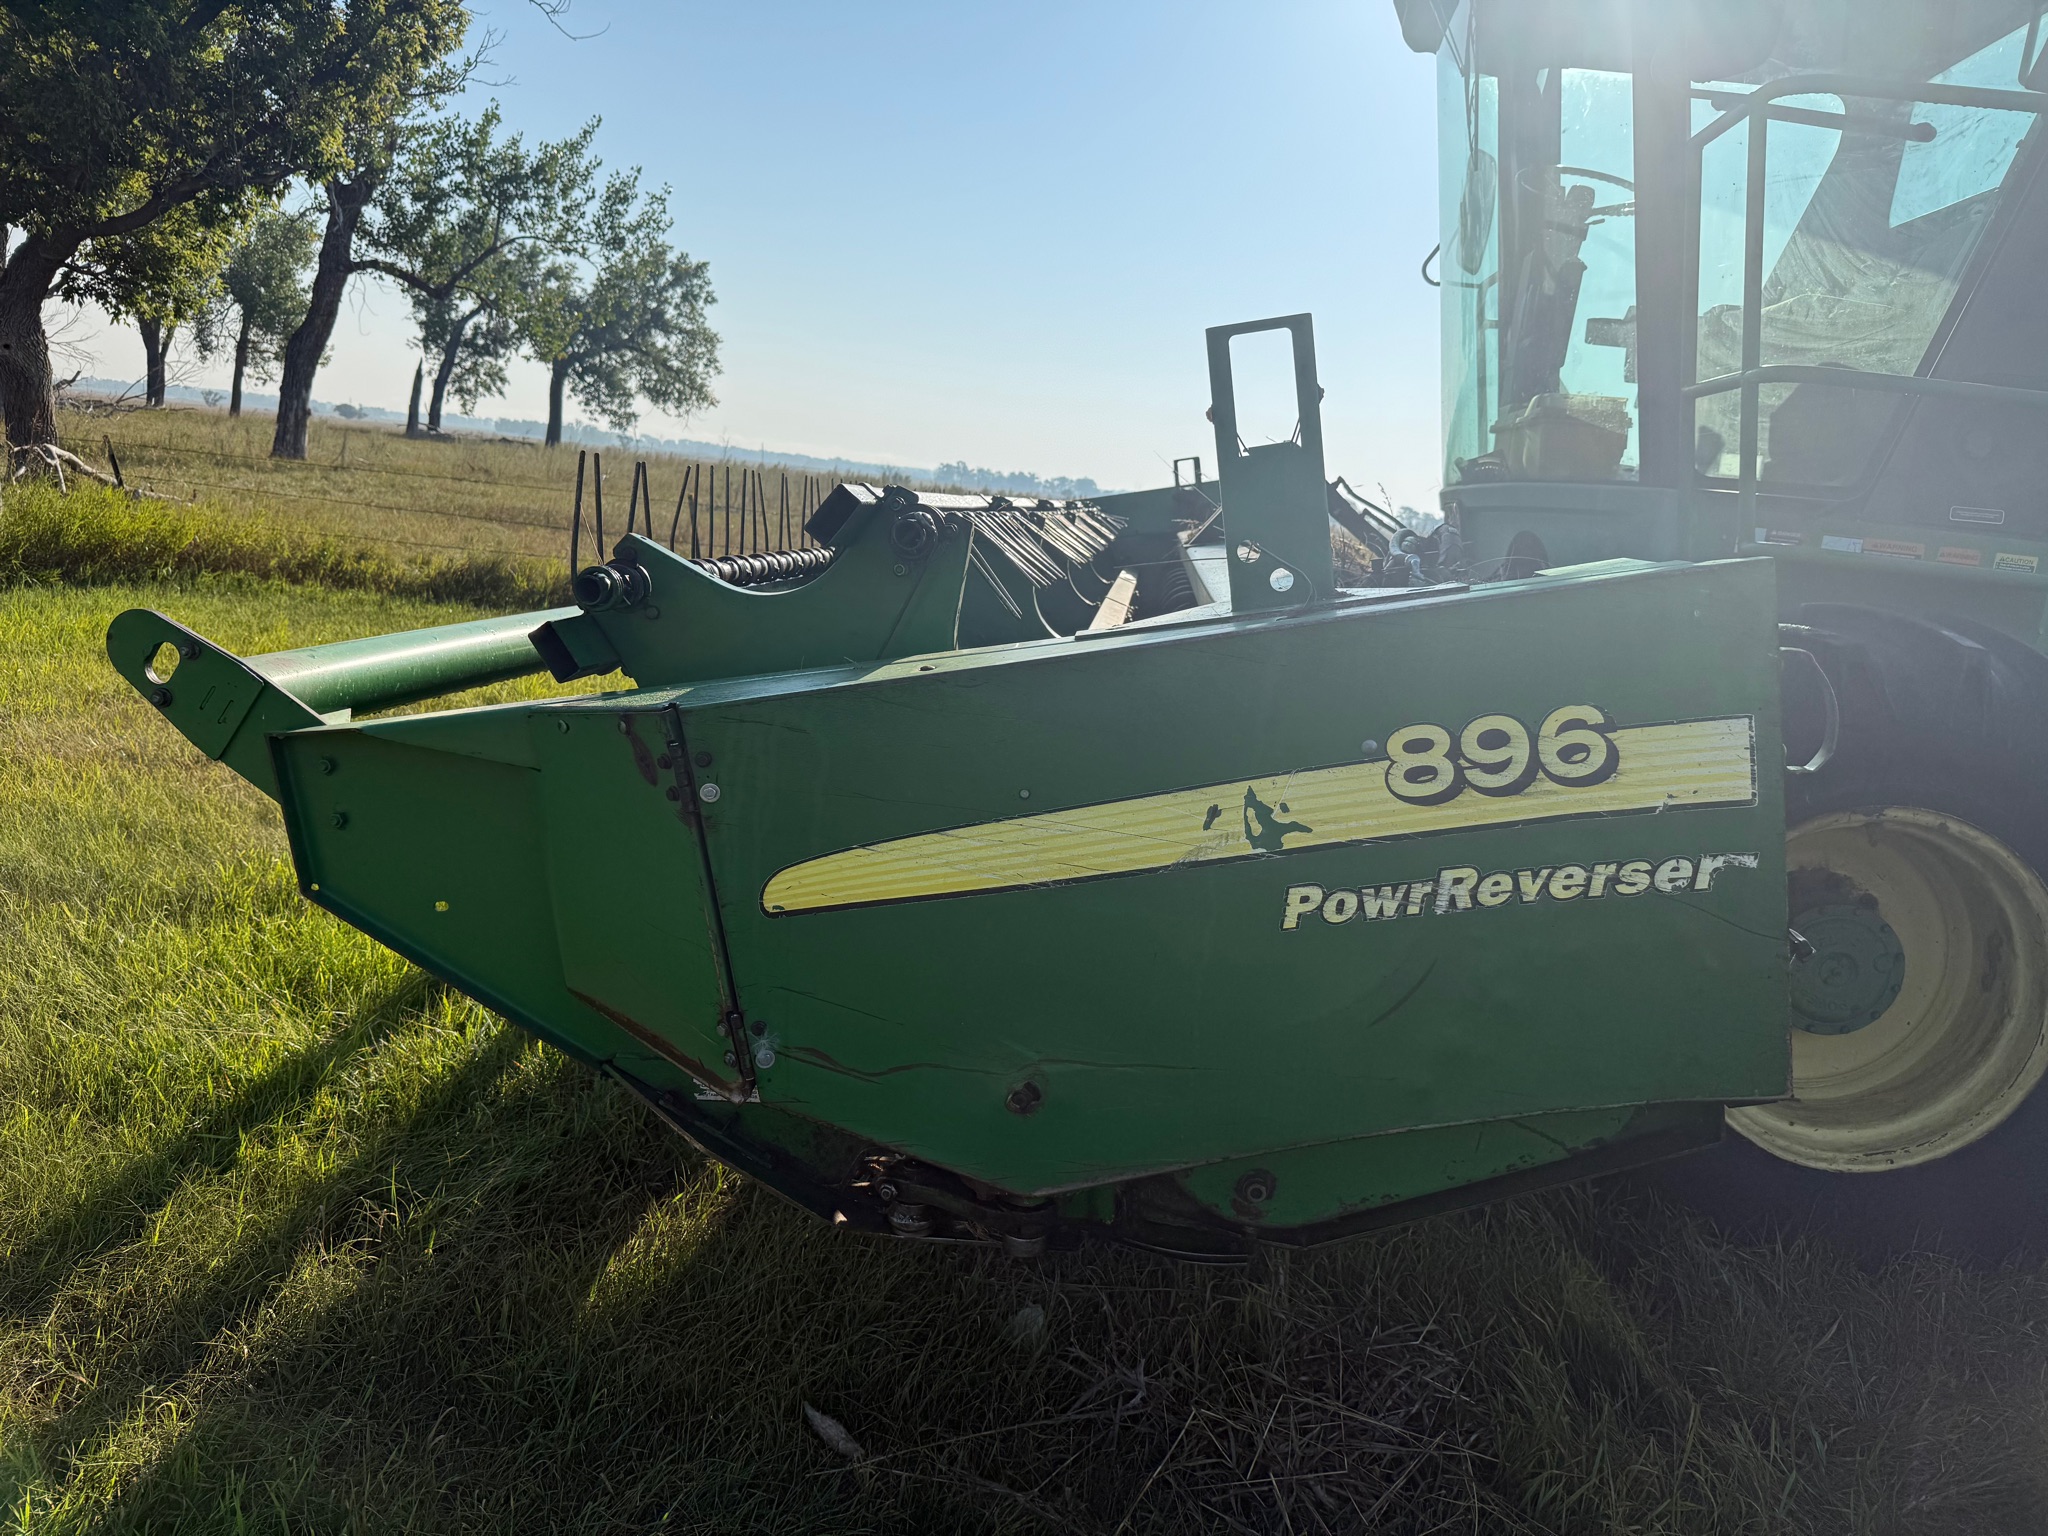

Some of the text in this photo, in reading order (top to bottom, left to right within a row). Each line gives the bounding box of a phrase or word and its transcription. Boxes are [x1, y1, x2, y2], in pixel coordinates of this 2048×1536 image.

[1879, 542, 1919, 554] WARNING
[2005, 555, 2035, 566] CAUTION
[1385, 703, 1618, 805] 896
[1280, 853, 1760, 931] PowrReverser
